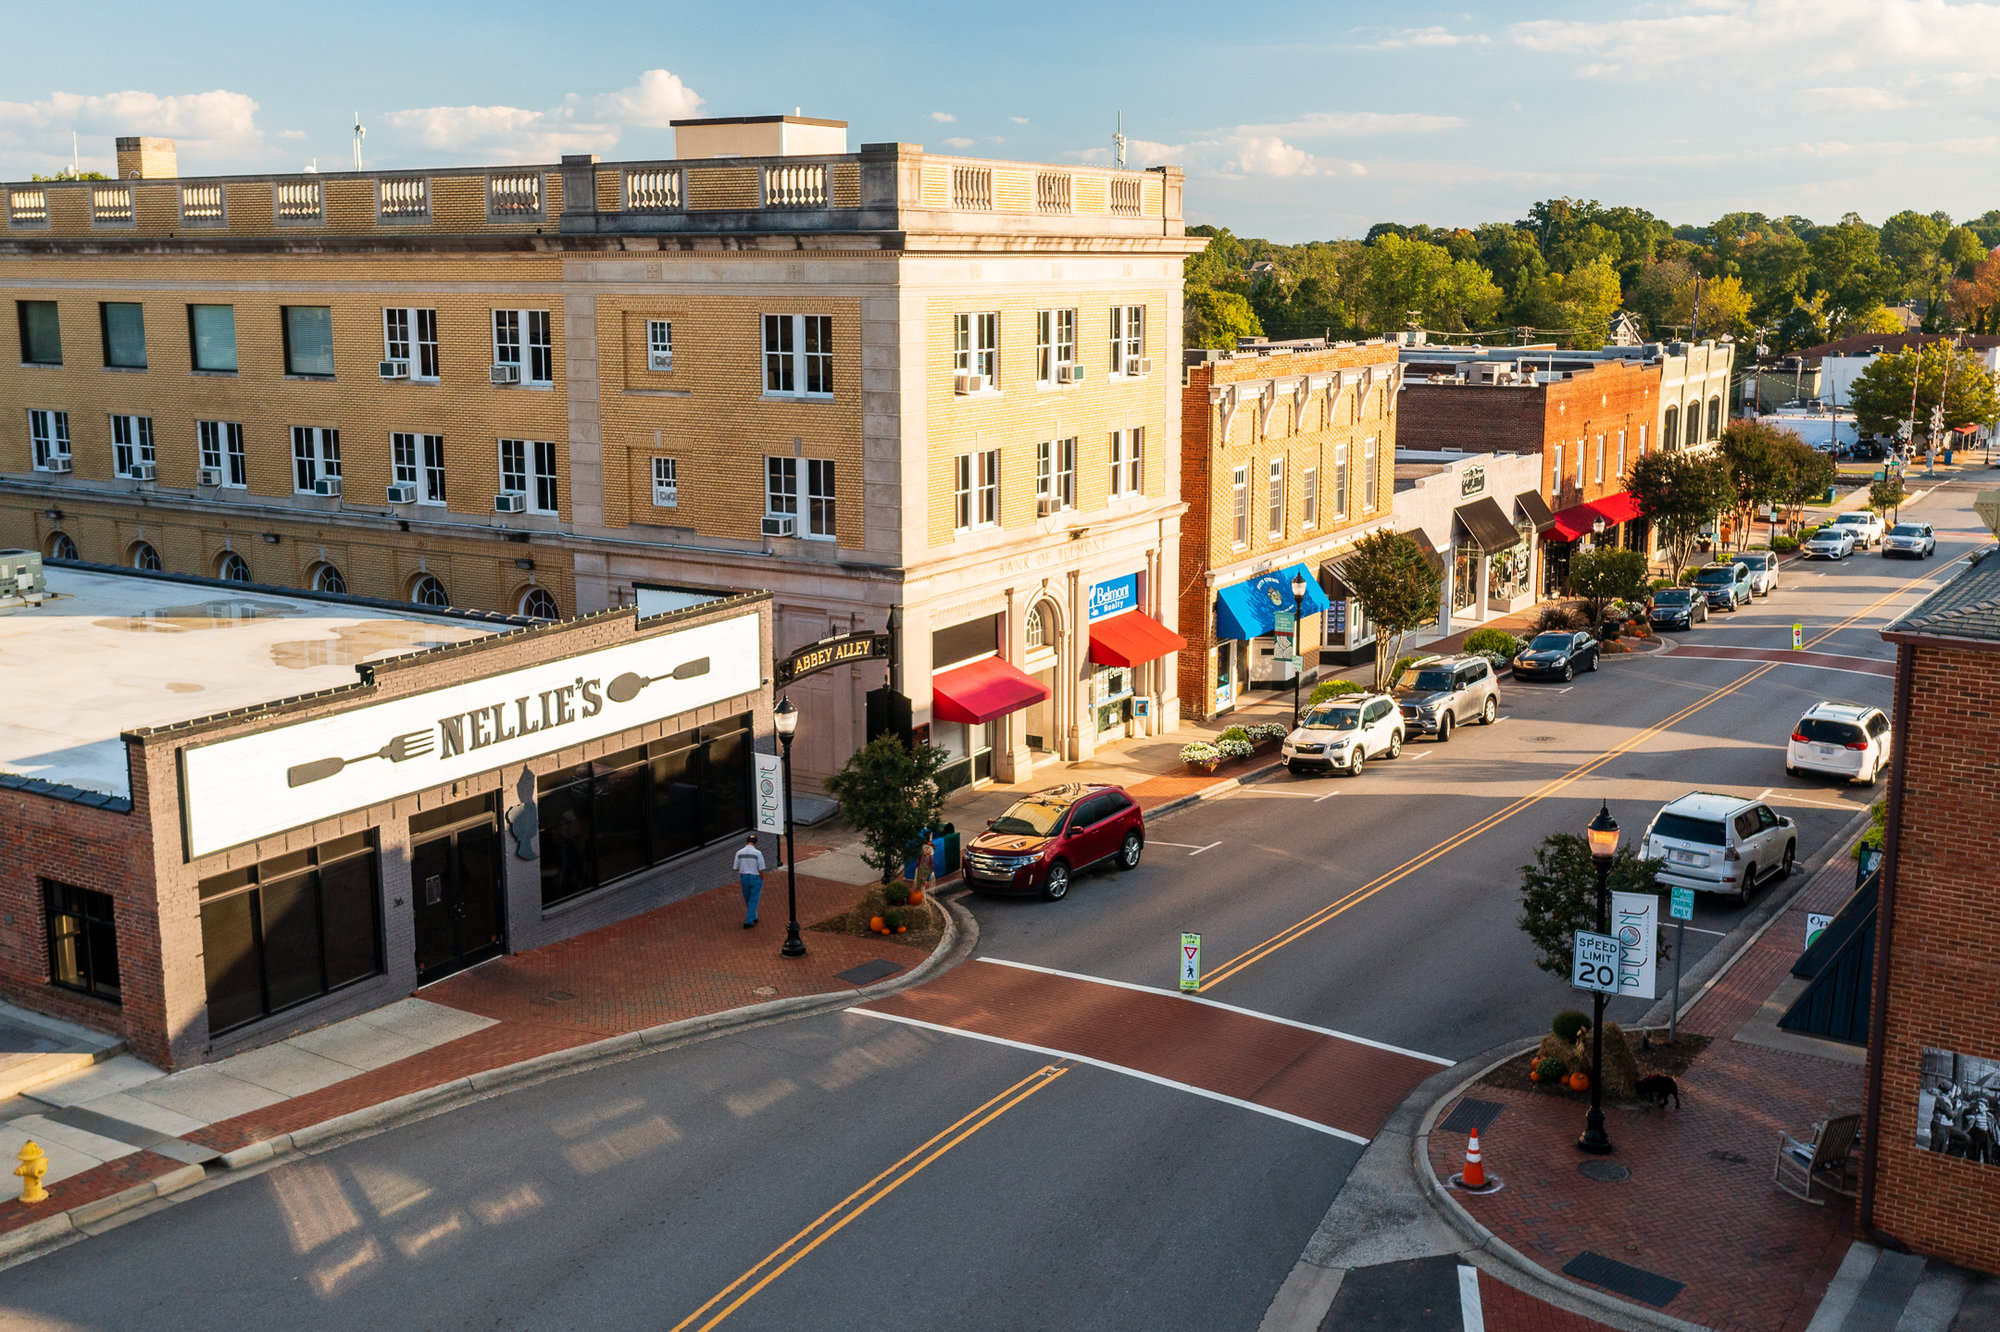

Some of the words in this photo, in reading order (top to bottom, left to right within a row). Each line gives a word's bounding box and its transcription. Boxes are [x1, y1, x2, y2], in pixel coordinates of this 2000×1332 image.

[1000, 556, 1030, 575] BANK
[1037, 553, 1050, 566] OF
[1057, 538, 1107, 561] BELMONT
[1097, 584, 1130, 604] Belmont
[1103, 600, 1124, 612] Realty
[795, 647, 833, 674] ABBEY
[835, 640, 871, 660] ALLEY
[438, 676, 603, 760] NELLIE'S
[1672, 900, 1692, 909] PARKING
[1673, 907, 1690, 917] ONLY
[1579, 937, 1617, 953] SPEED
[1582, 950, 1612, 964] LIMIT
[1579, 962, 1614, 986] 20
